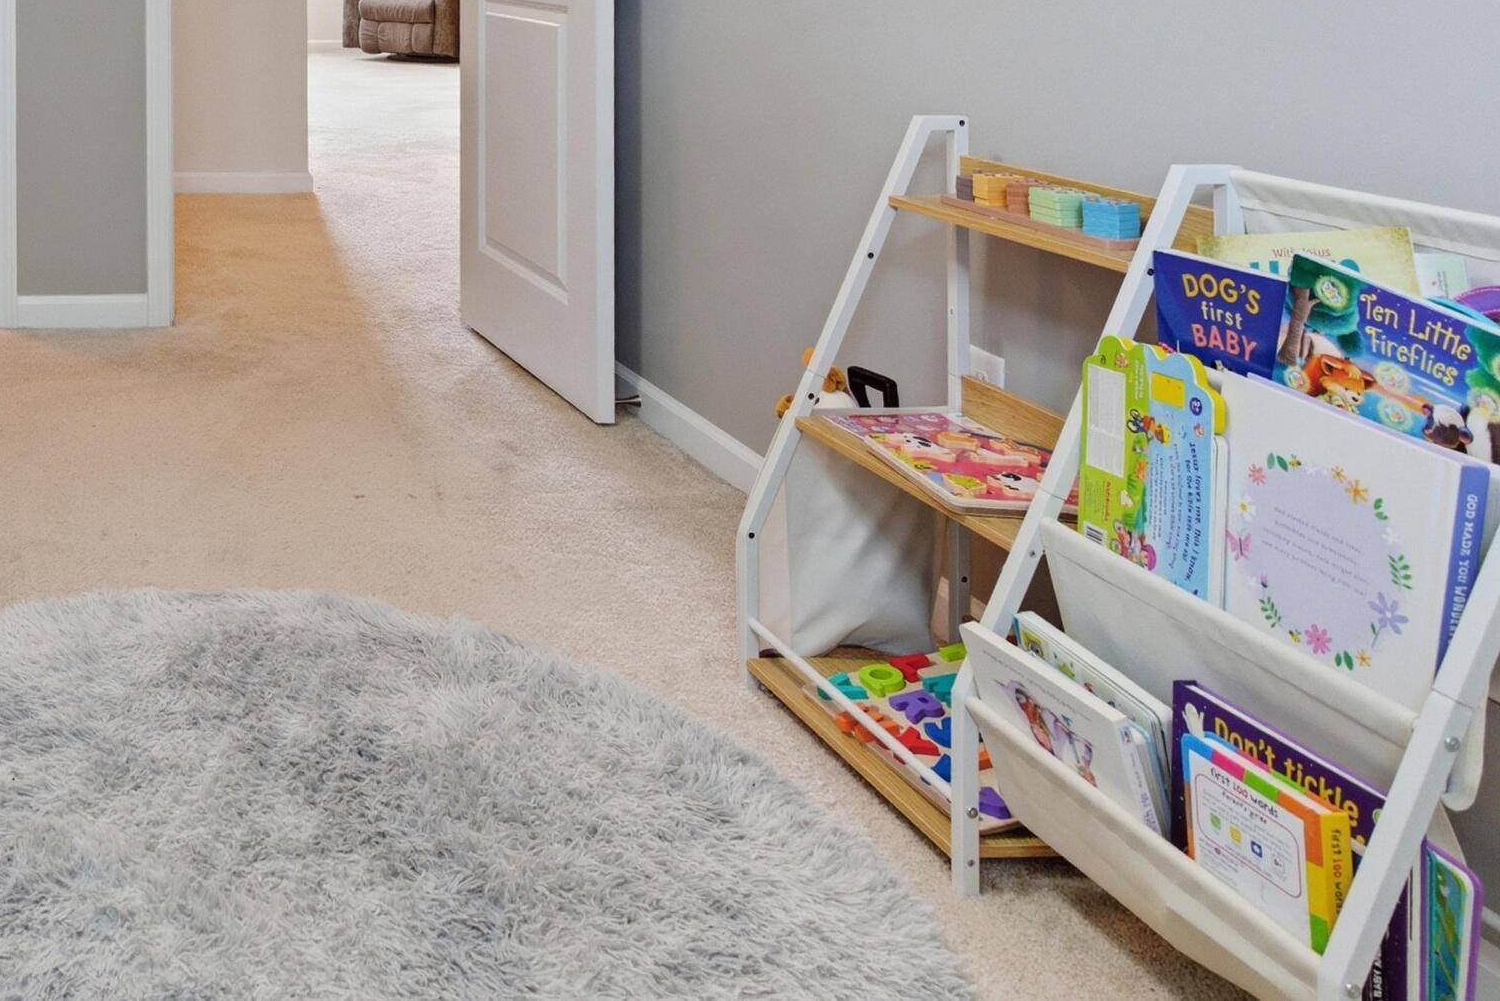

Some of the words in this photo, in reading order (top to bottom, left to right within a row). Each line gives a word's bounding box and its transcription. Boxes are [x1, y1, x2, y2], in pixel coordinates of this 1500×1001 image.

[1181, 273, 1261, 315] DOG'S
[1201, 300, 1243, 330] first
[1360, 293, 1399, 330] Ten
[1408, 309, 1472, 361] Little
[1191, 323, 1257, 361] BABY
[1364, 325, 1459, 387] Fireflies
[1465, 494, 1478, 519] GOD
[1460, 521, 1475, 556] MADE
[1458, 559, 1470, 583] YOU
[1214, 716, 1276, 773] Don't
[1283, 757, 1360, 820] tickle
[1232, 782, 1249, 799] 100
[1250, 794, 1278, 818] words
[1331, 829, 1341, 855] first
[1333, 859, 1342, 878] 100
[1373, 968, 1382, 998] BABY
